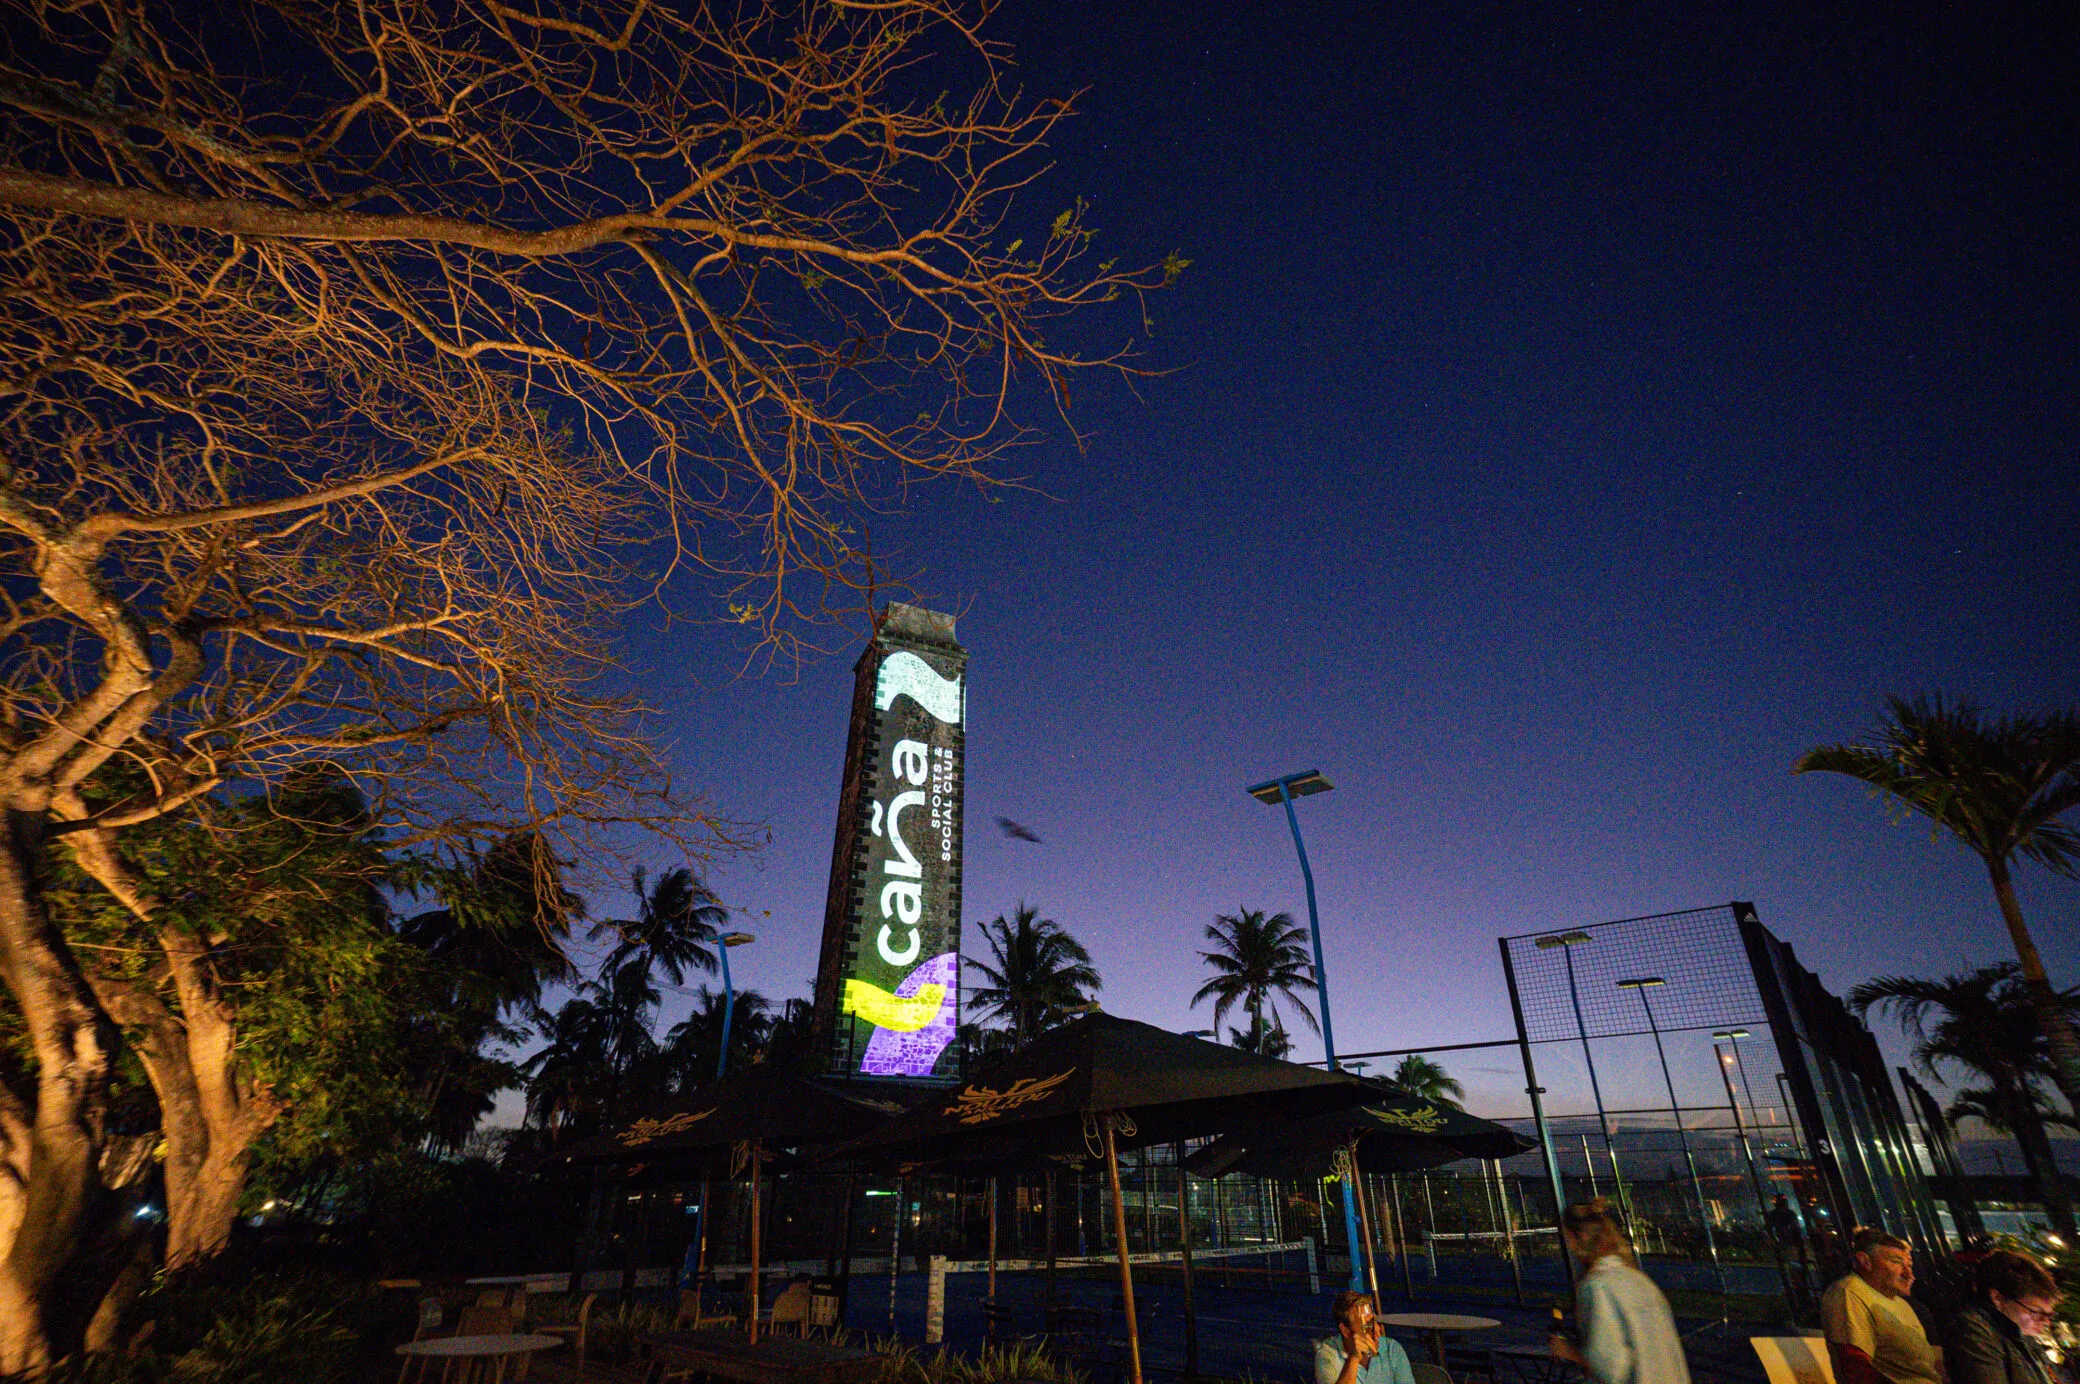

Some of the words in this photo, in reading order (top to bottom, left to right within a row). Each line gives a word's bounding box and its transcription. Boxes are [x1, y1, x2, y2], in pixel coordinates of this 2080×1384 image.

[933, 746, 943, 757] &
[943, 749, 953, 794] CLUB
[931, 763, 943, 829] SPORTS
[871, 739, 928, 966] caña
[942, 799, 953, 862] SOCIAL
[1817, 1139, 1831, 1155] 3
